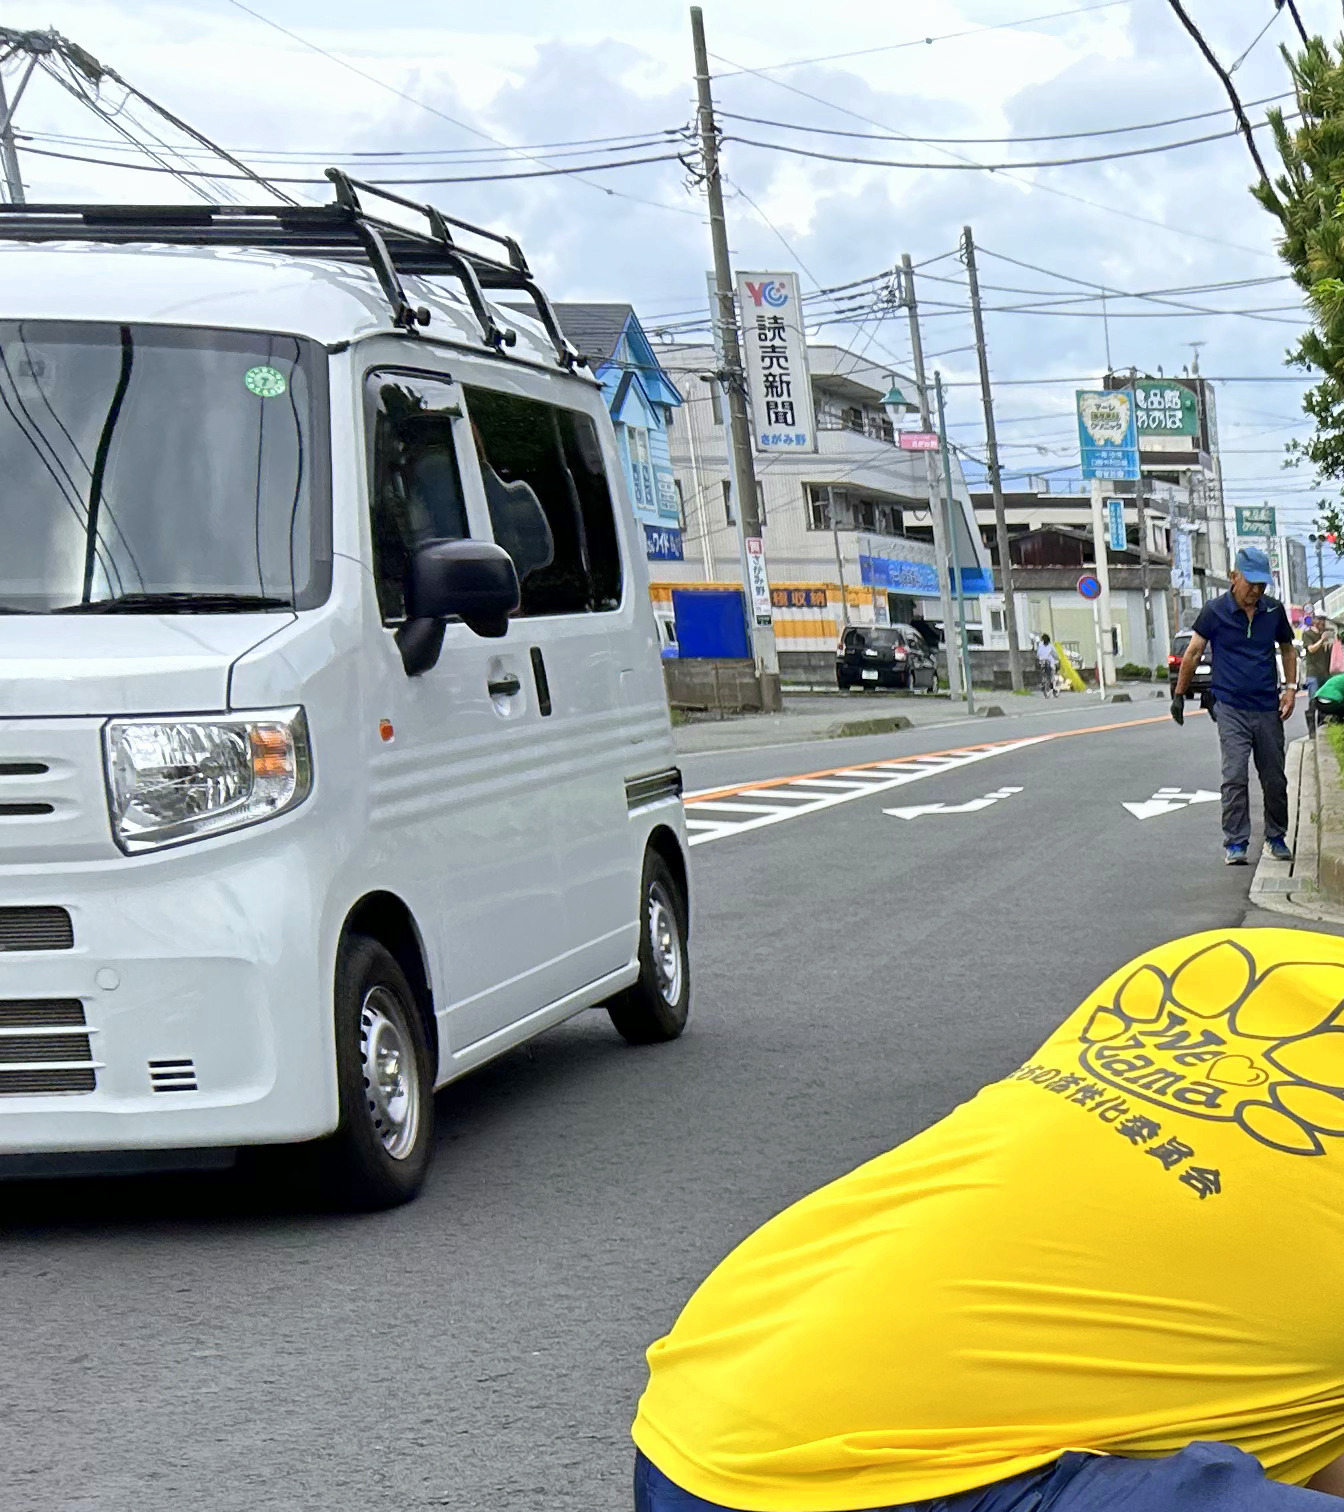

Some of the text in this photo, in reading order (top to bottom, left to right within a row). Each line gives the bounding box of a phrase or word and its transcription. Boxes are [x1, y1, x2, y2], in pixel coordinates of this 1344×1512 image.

[756, 315, 796, 426] 読売新聞
[760, 433, 806, 446] さがみ野
[1137, 1011, 1228, 1067] We
